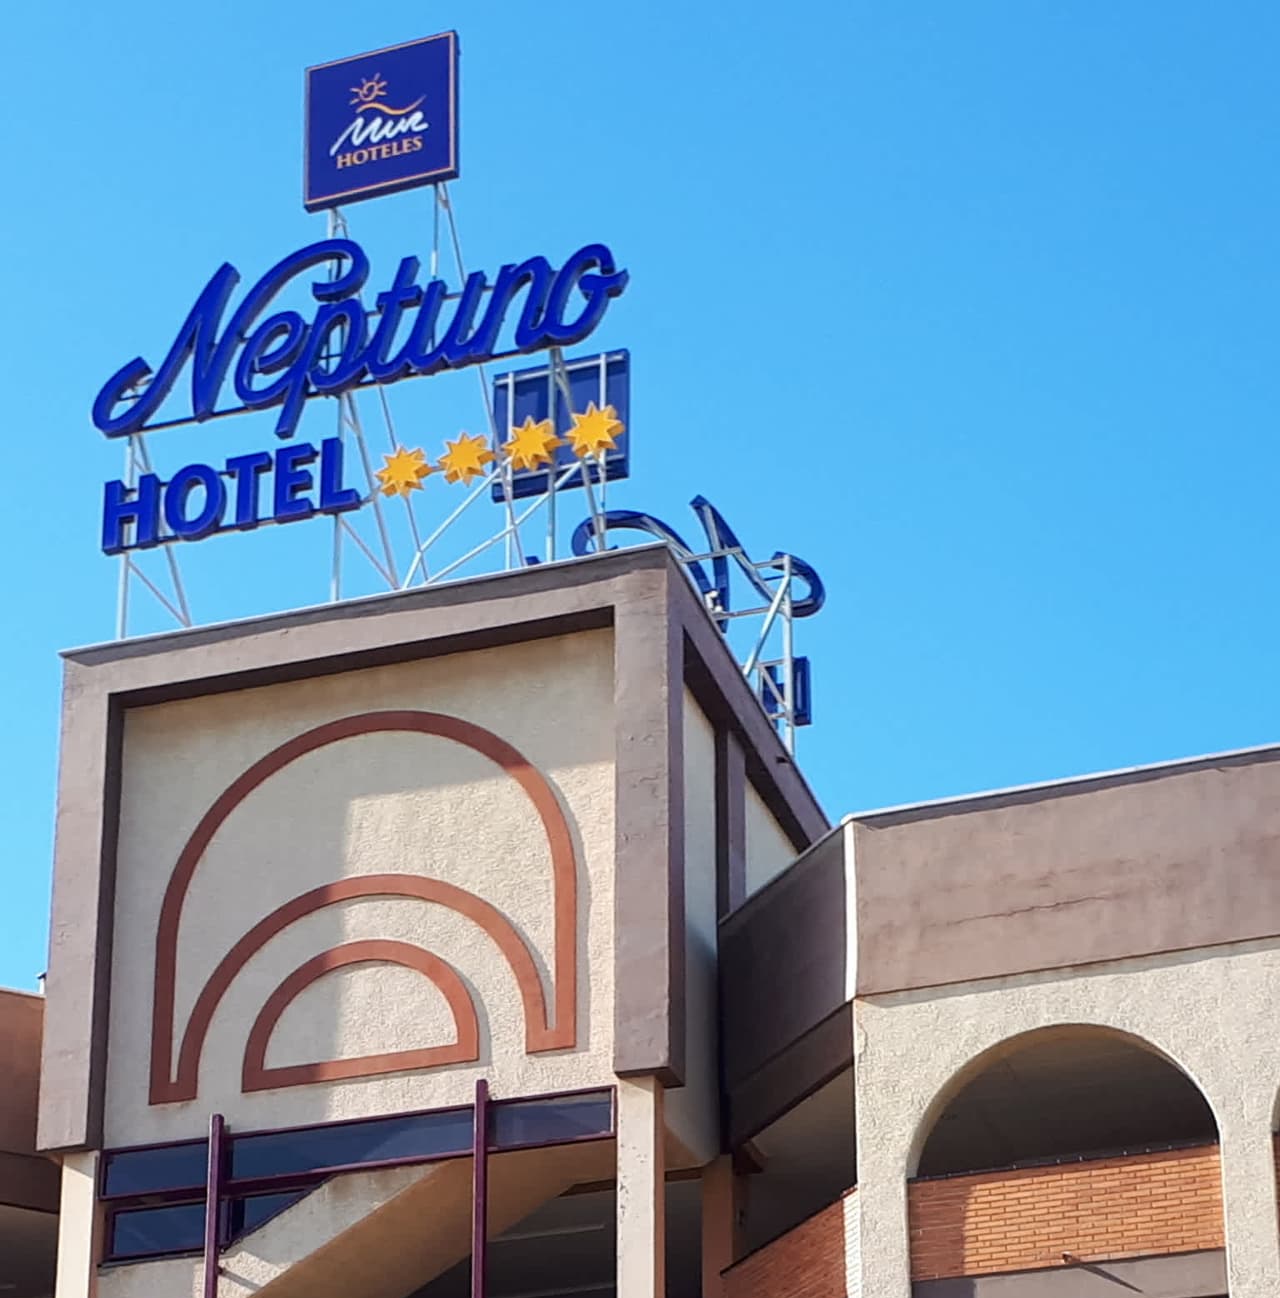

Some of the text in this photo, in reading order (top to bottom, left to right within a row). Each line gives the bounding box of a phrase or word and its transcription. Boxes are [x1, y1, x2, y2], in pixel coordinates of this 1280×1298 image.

[336, 136, 423, 169] HOTELES
[92, 238, 629, 438] Neptuno
[102, 438, 360, 555] HOTEL
